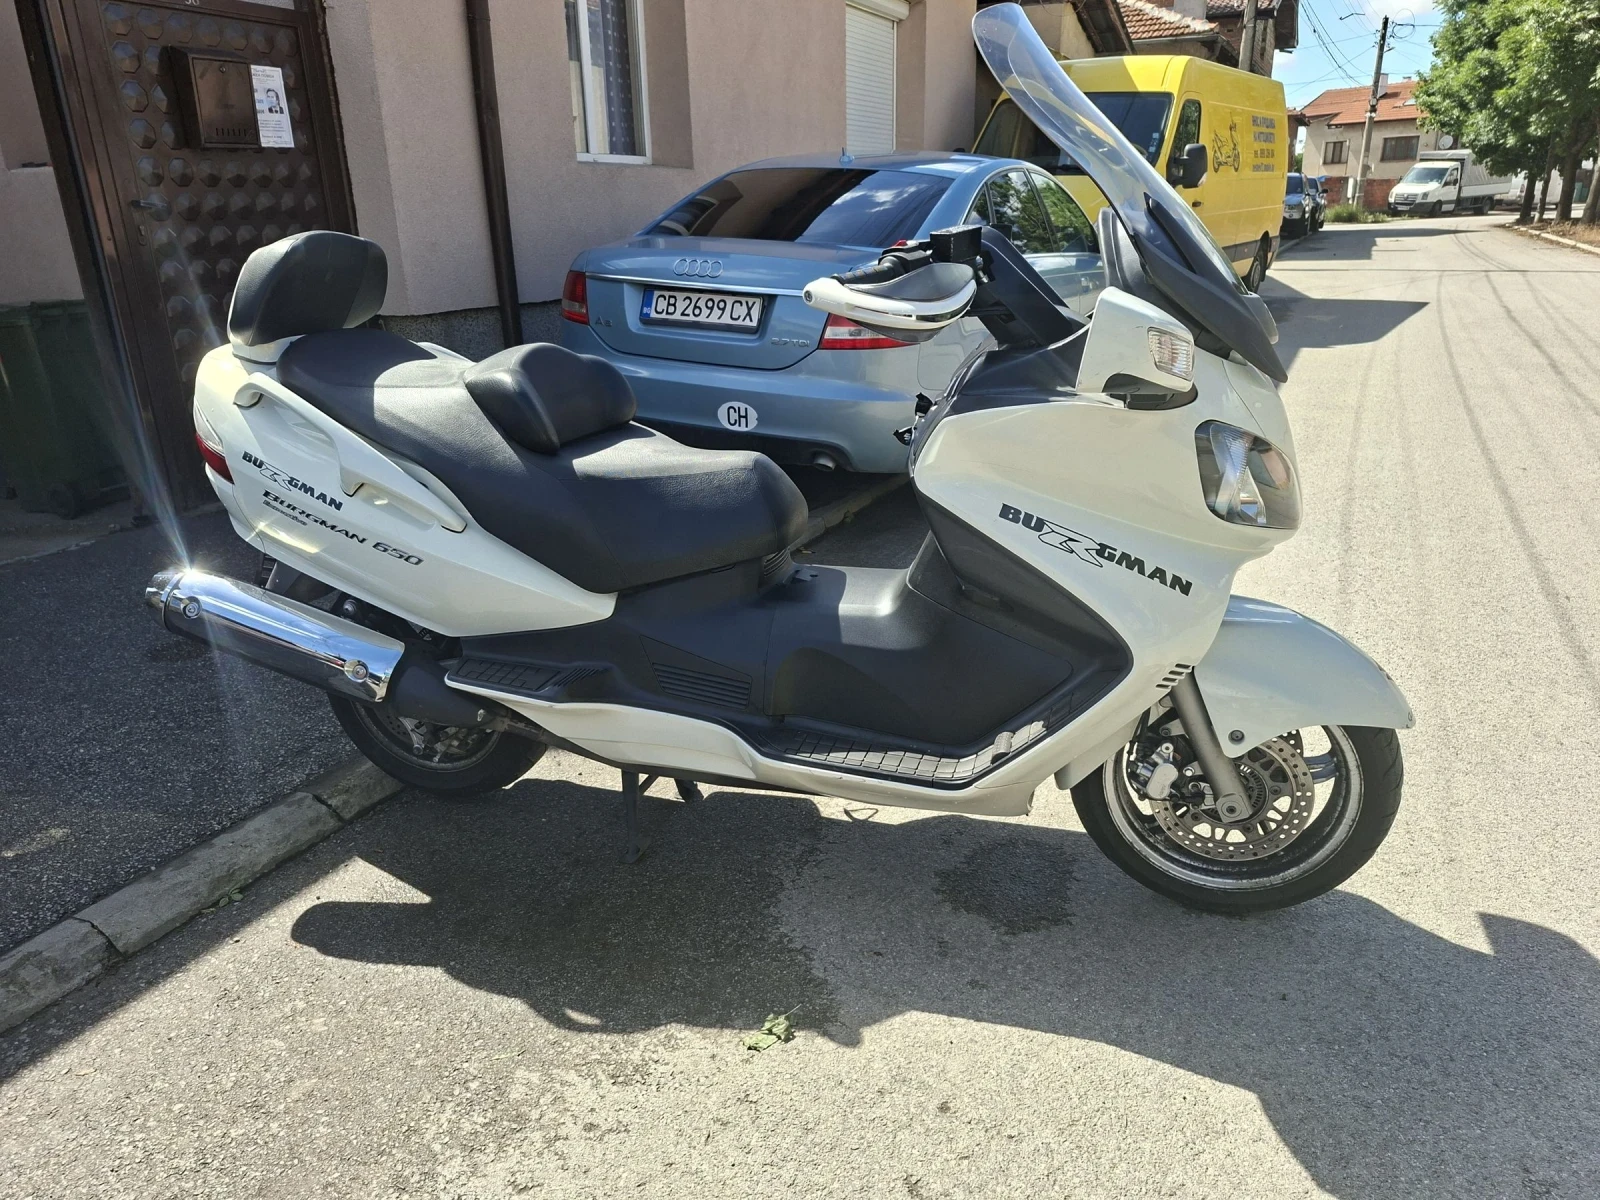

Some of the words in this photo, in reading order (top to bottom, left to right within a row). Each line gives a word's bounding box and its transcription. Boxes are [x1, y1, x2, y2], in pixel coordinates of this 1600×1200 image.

[727, 404, 749, 429] CH
[242, 450, 343, 512] BURGMAN
[262, 489, 369, 544] BURGMAN
[372, 541, 425, 566] 650
[998, 502, 1193, 597] BURGMAN
